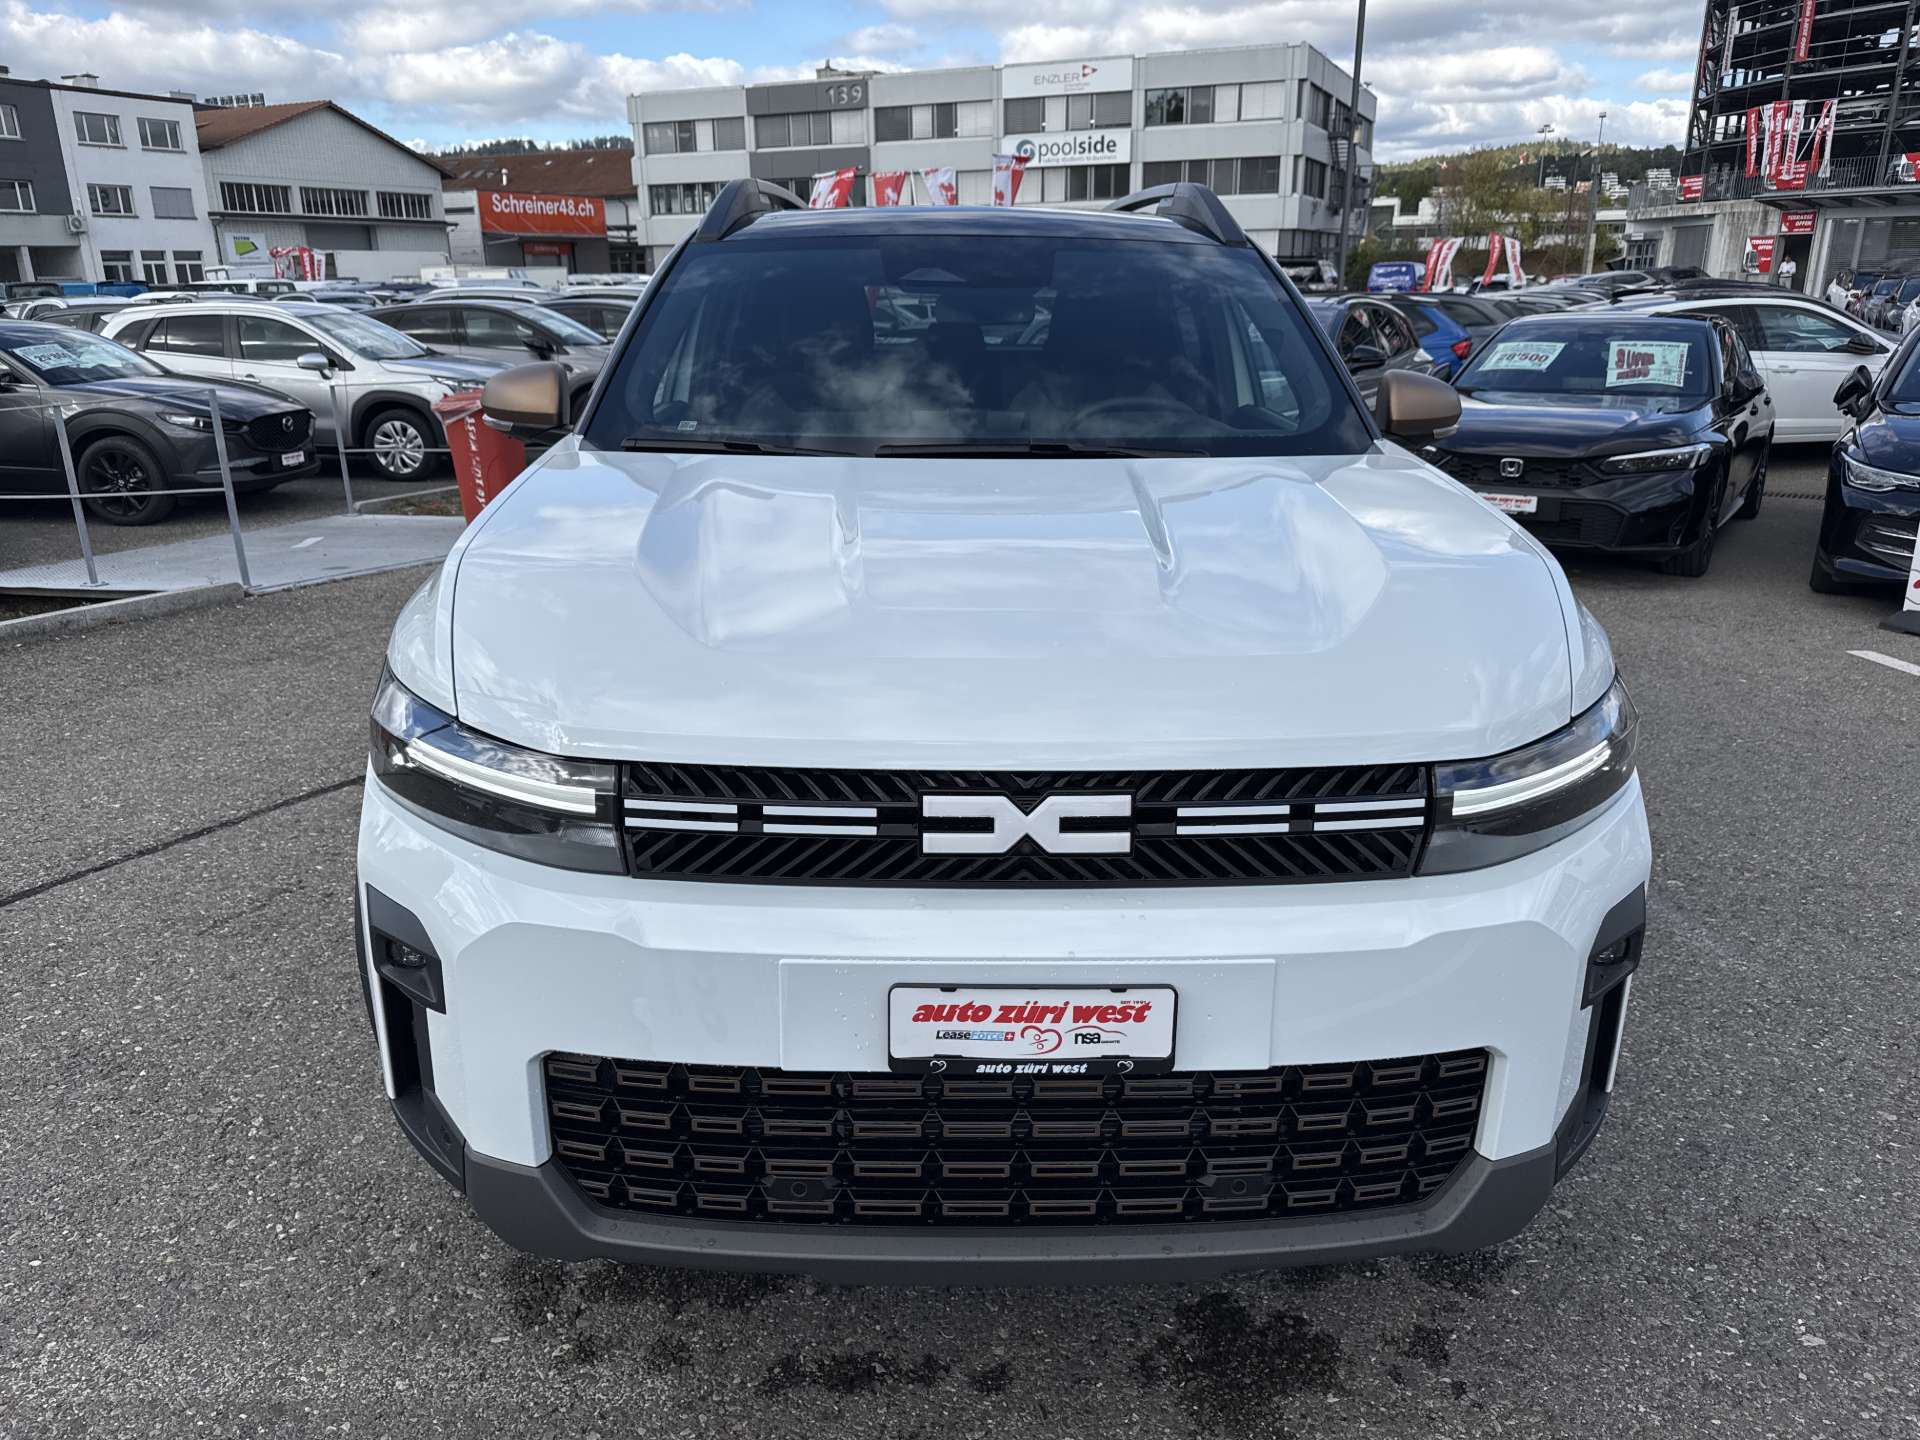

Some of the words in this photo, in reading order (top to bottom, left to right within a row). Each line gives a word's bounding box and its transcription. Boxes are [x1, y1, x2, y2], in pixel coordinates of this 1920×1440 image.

[1033, 72, 1081, 86] ENZLER
[825, 85, 862, 105] 139
[1038, 135, 1117, 163] poolside
[491, 193, 595, 217] Schreiner48.ch
[912, 1000, 992, 1023] auto
[992, 1000, 1070, 1024] züri
[1072, 1001, 1153, 1023] west
[936, 1030, 1004, 1041] LeaseForce
[1074, 1032, 1101, 1045] nsa
[976, 1063, 1012, 1074] auto
[1014, 1062, 1049, 1074] züri
[1051, 1062, 1088, 1074] west
